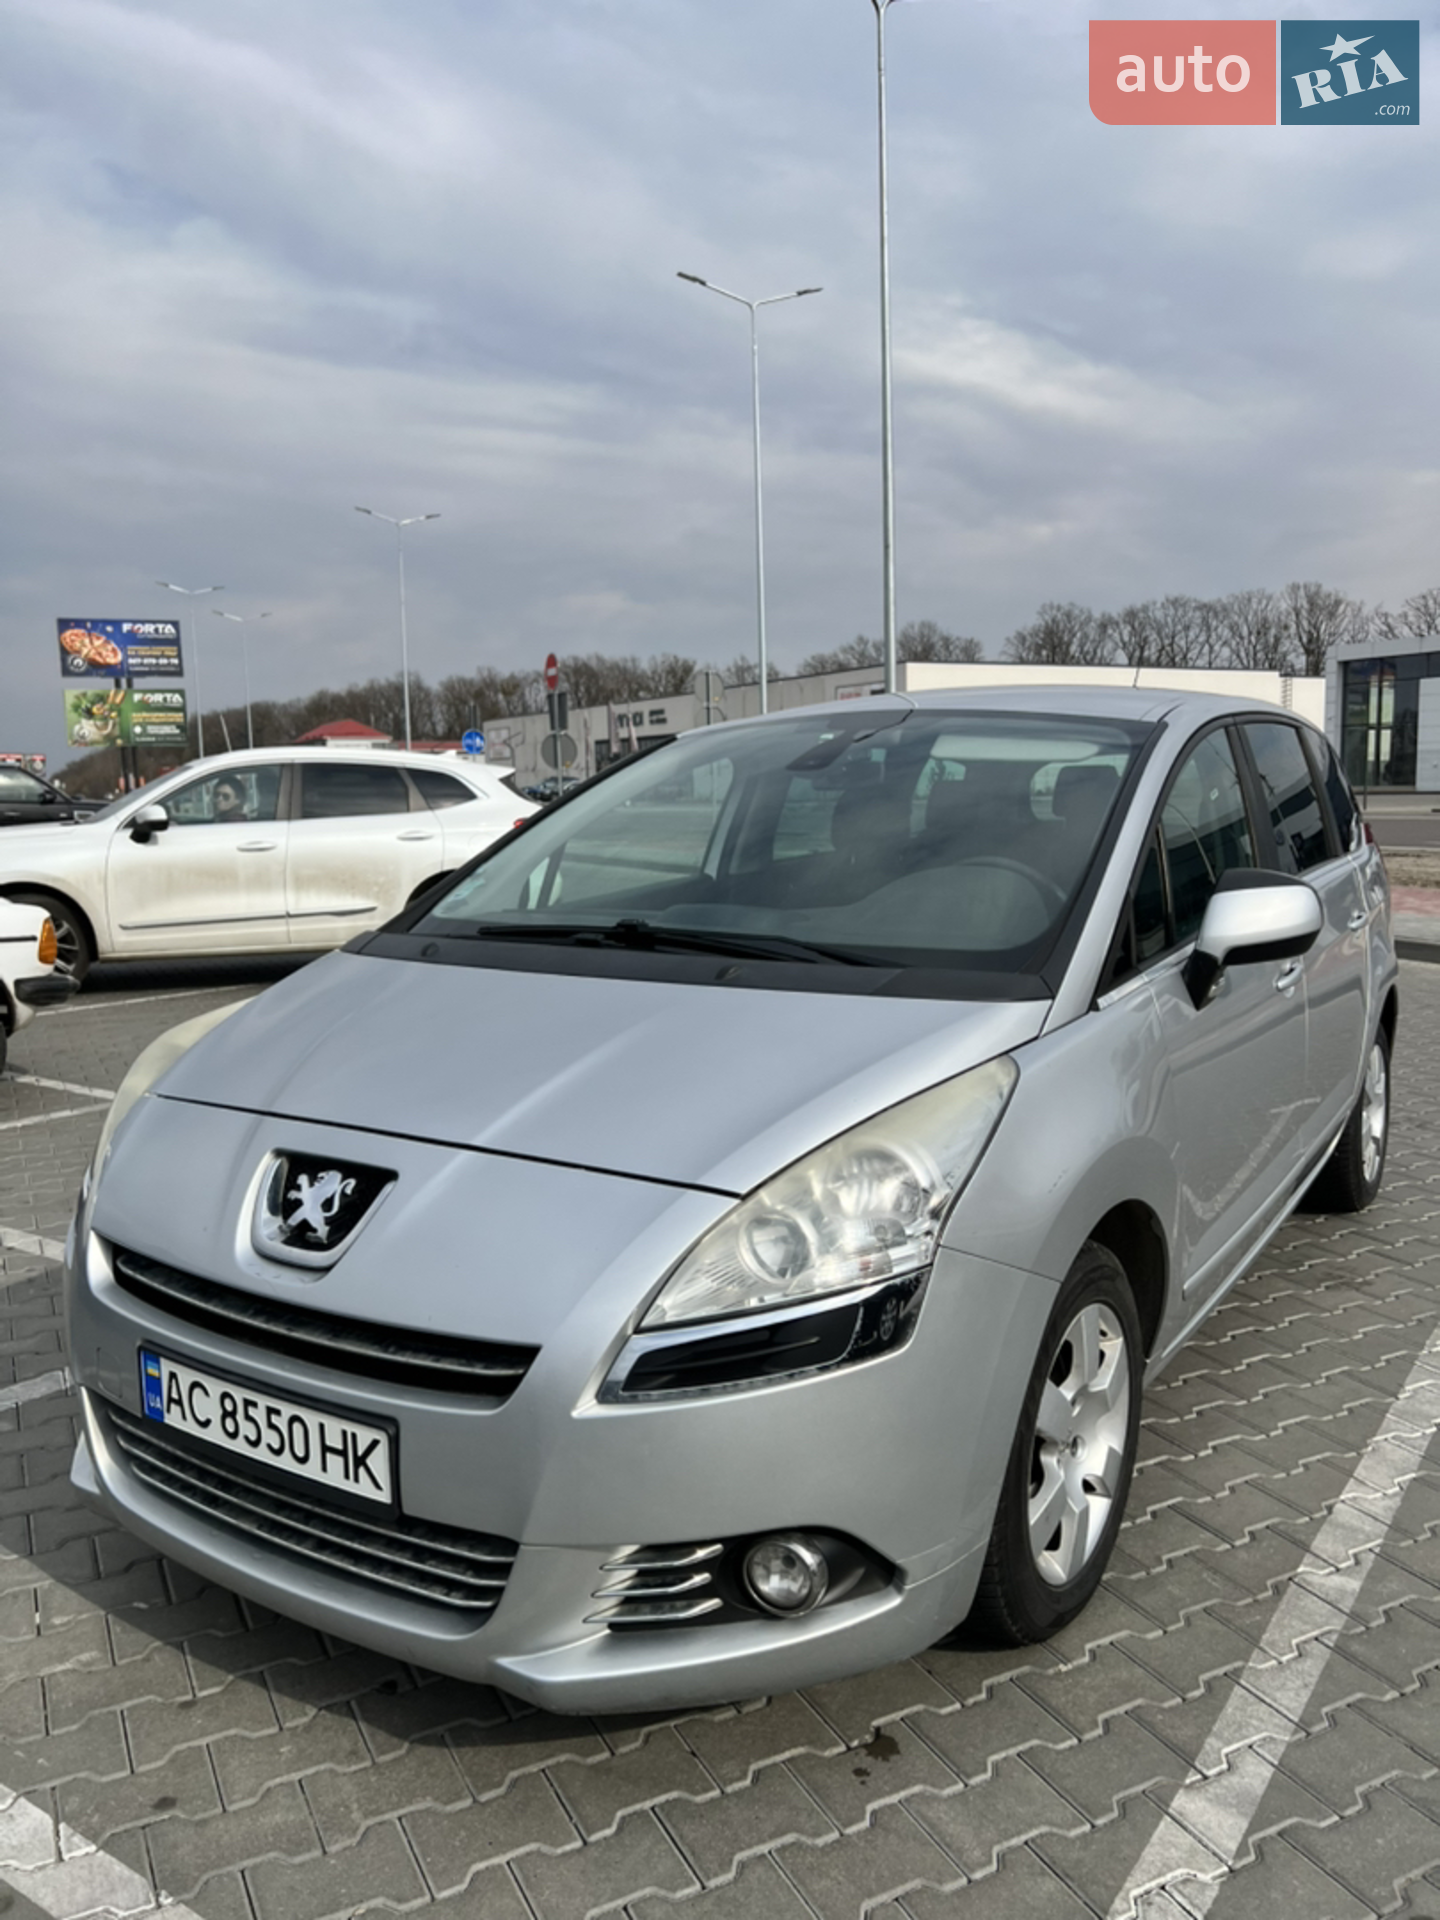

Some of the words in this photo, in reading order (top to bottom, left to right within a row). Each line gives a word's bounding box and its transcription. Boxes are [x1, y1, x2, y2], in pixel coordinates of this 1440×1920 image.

[122, 623, 176, 634] FORTA
[133, 693, 183, 704] FORTA
[148, 1391, 163, 1412] UA
[166, 1370, 212, 1429] AC
[219, 1391, 310, 1466] 8550
[318, 1421, 384, 1492] HK
